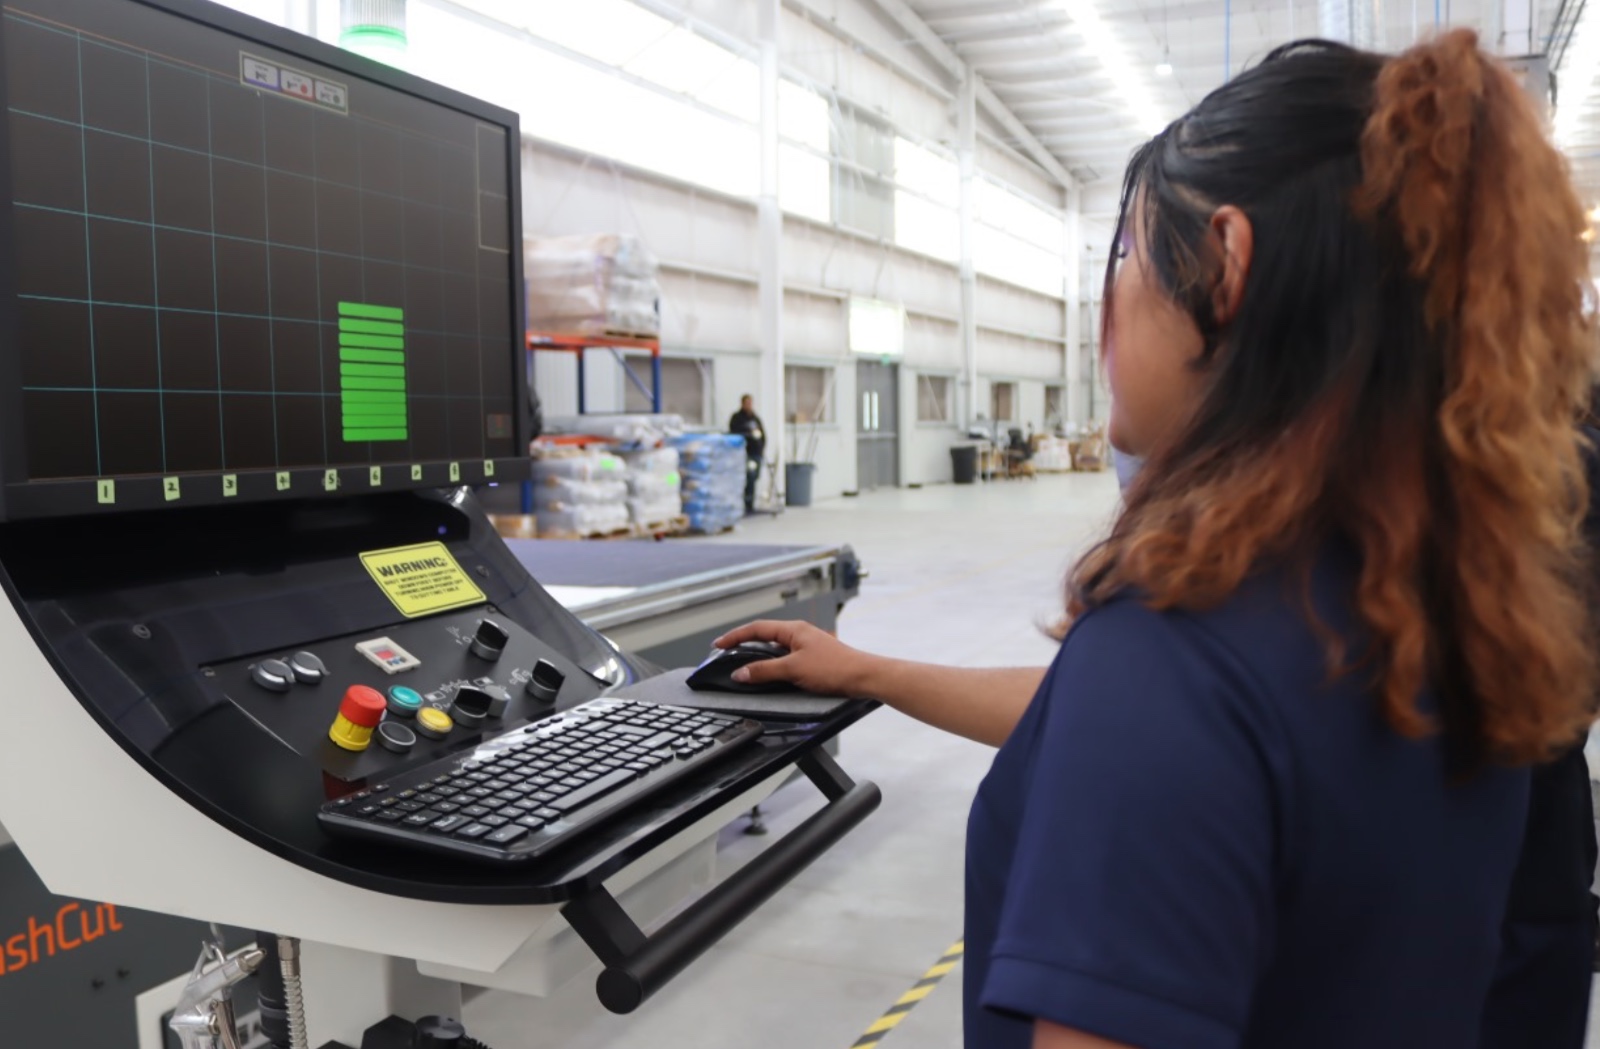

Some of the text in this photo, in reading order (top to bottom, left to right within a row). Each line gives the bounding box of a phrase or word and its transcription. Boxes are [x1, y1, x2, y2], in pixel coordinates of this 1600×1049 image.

[167, 482, 178, 492] 2
[225, 479, 234, 489] 3
[278, 475, 288, 487] 4
[328, 473, 335, 484] 5
[372, 470, 379, 481] 6
[0, 902, 124, 976] shCut
